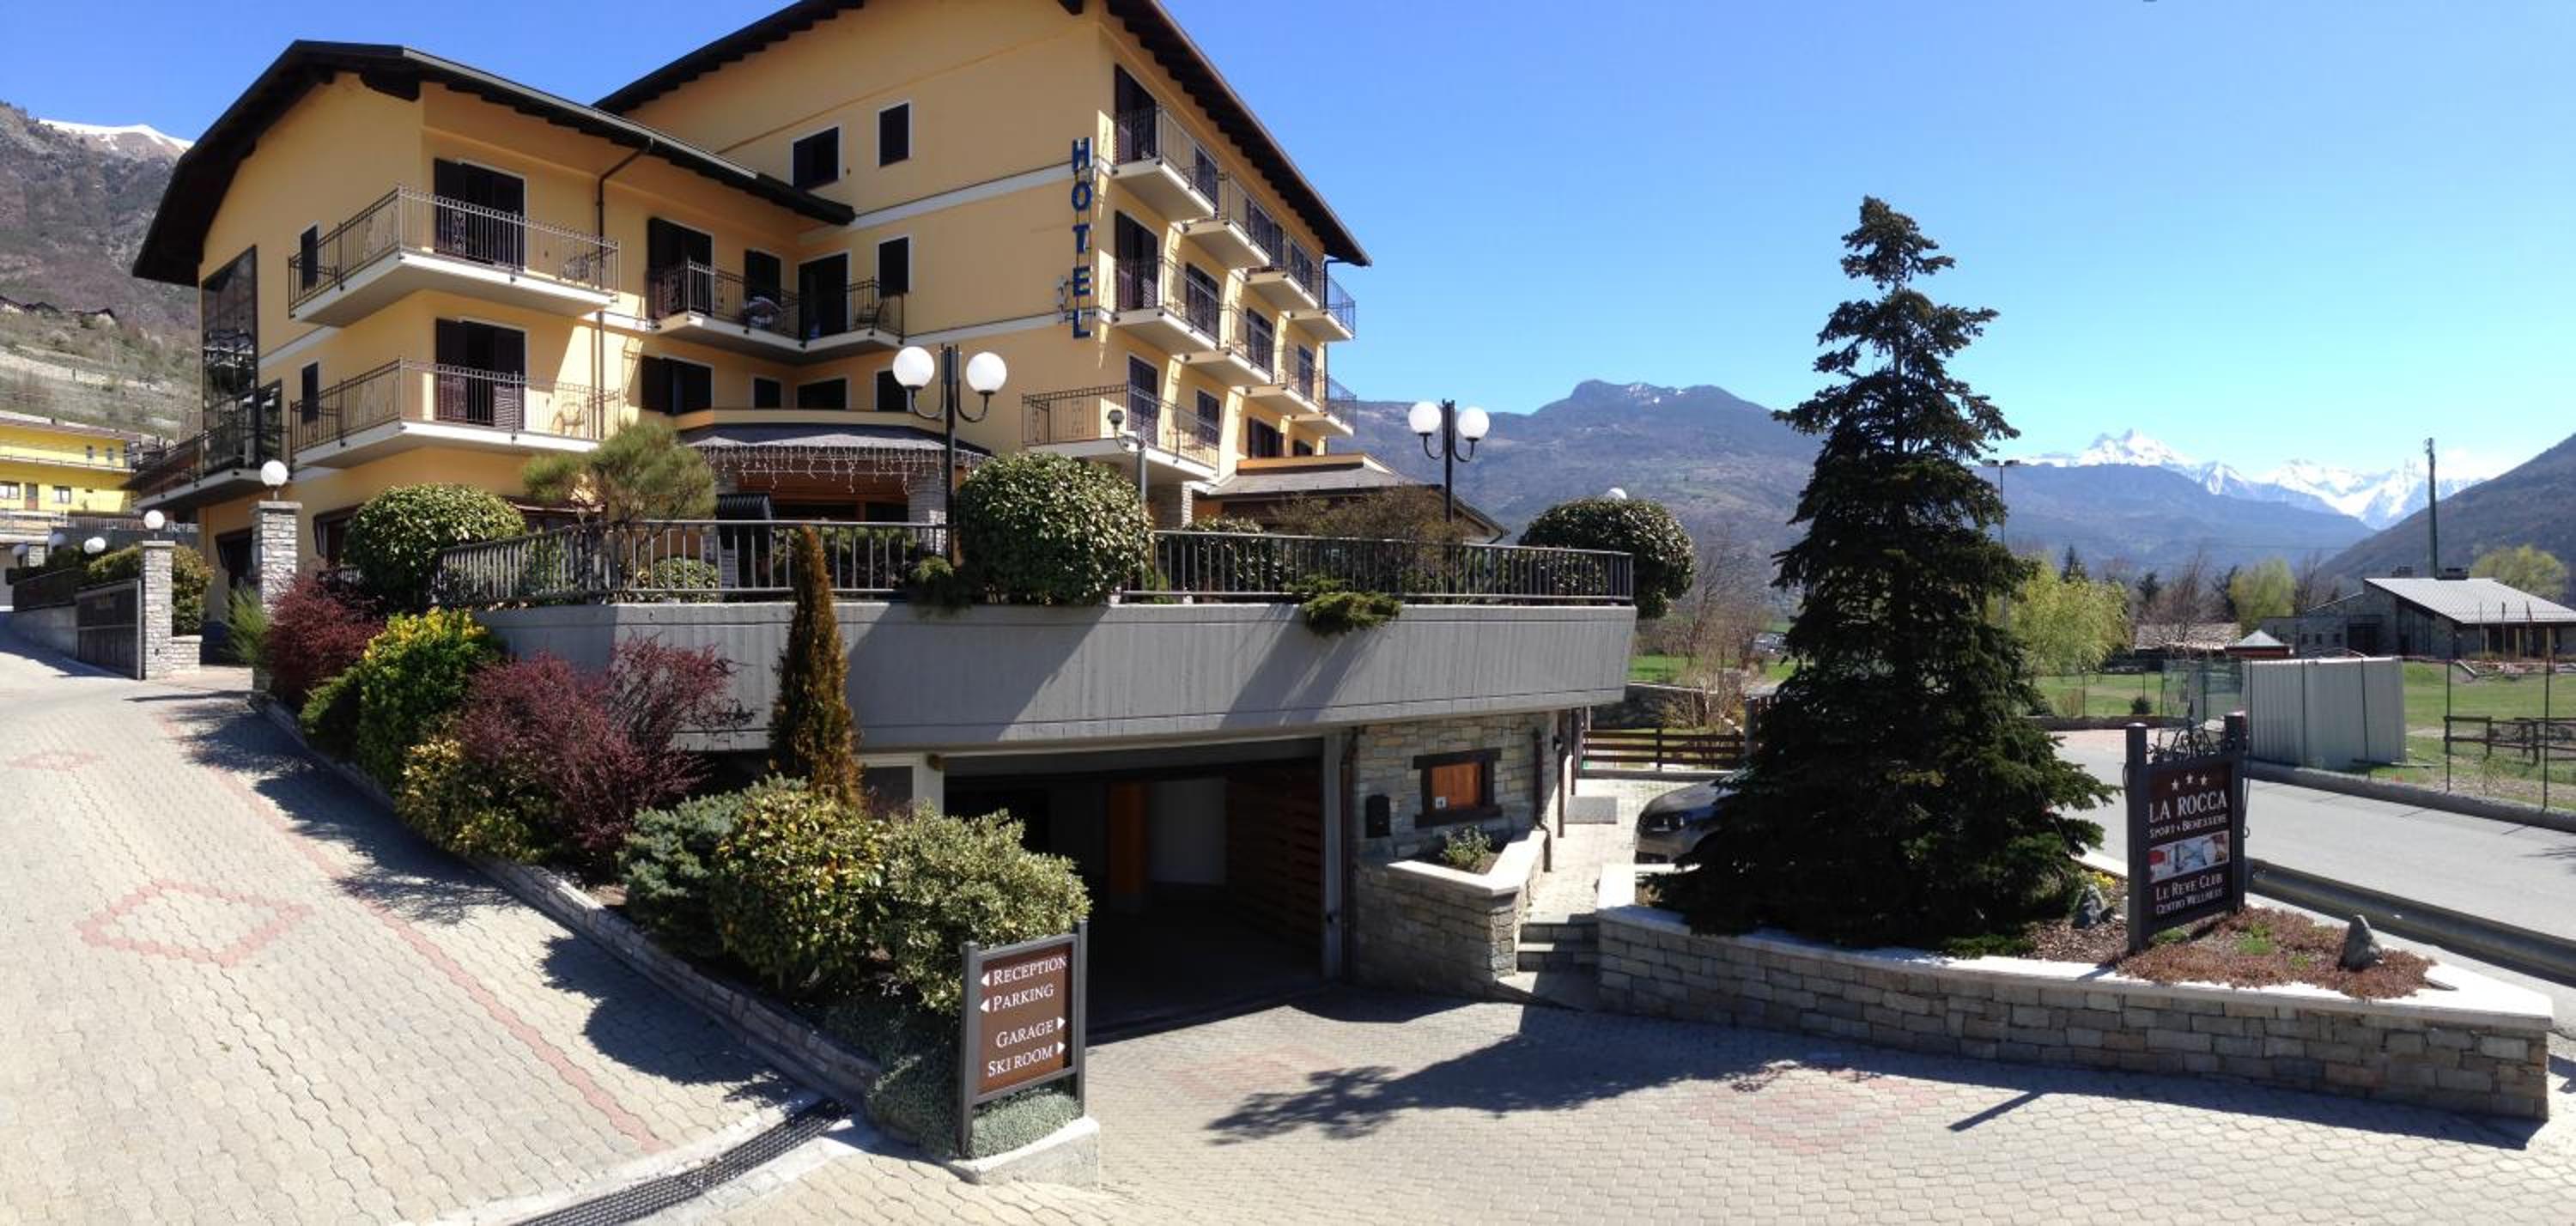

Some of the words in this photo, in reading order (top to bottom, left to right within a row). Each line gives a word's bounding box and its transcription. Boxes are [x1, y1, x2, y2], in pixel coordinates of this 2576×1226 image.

[1072, 137, 1094, 338] HOTEL
[2149, 799, 2171, 823] LA
[2178, 789, 2227, 816] ROCCA
[993, 955, 1067, 986] RECEPTION
[993, 983, 1054, 1012] PARKING
[996, 1019, 1054, 1048] GARAGE
[988, 1057, 1012, 1077] SKI
[1014, 1044, 1054, 1069] ROOM
